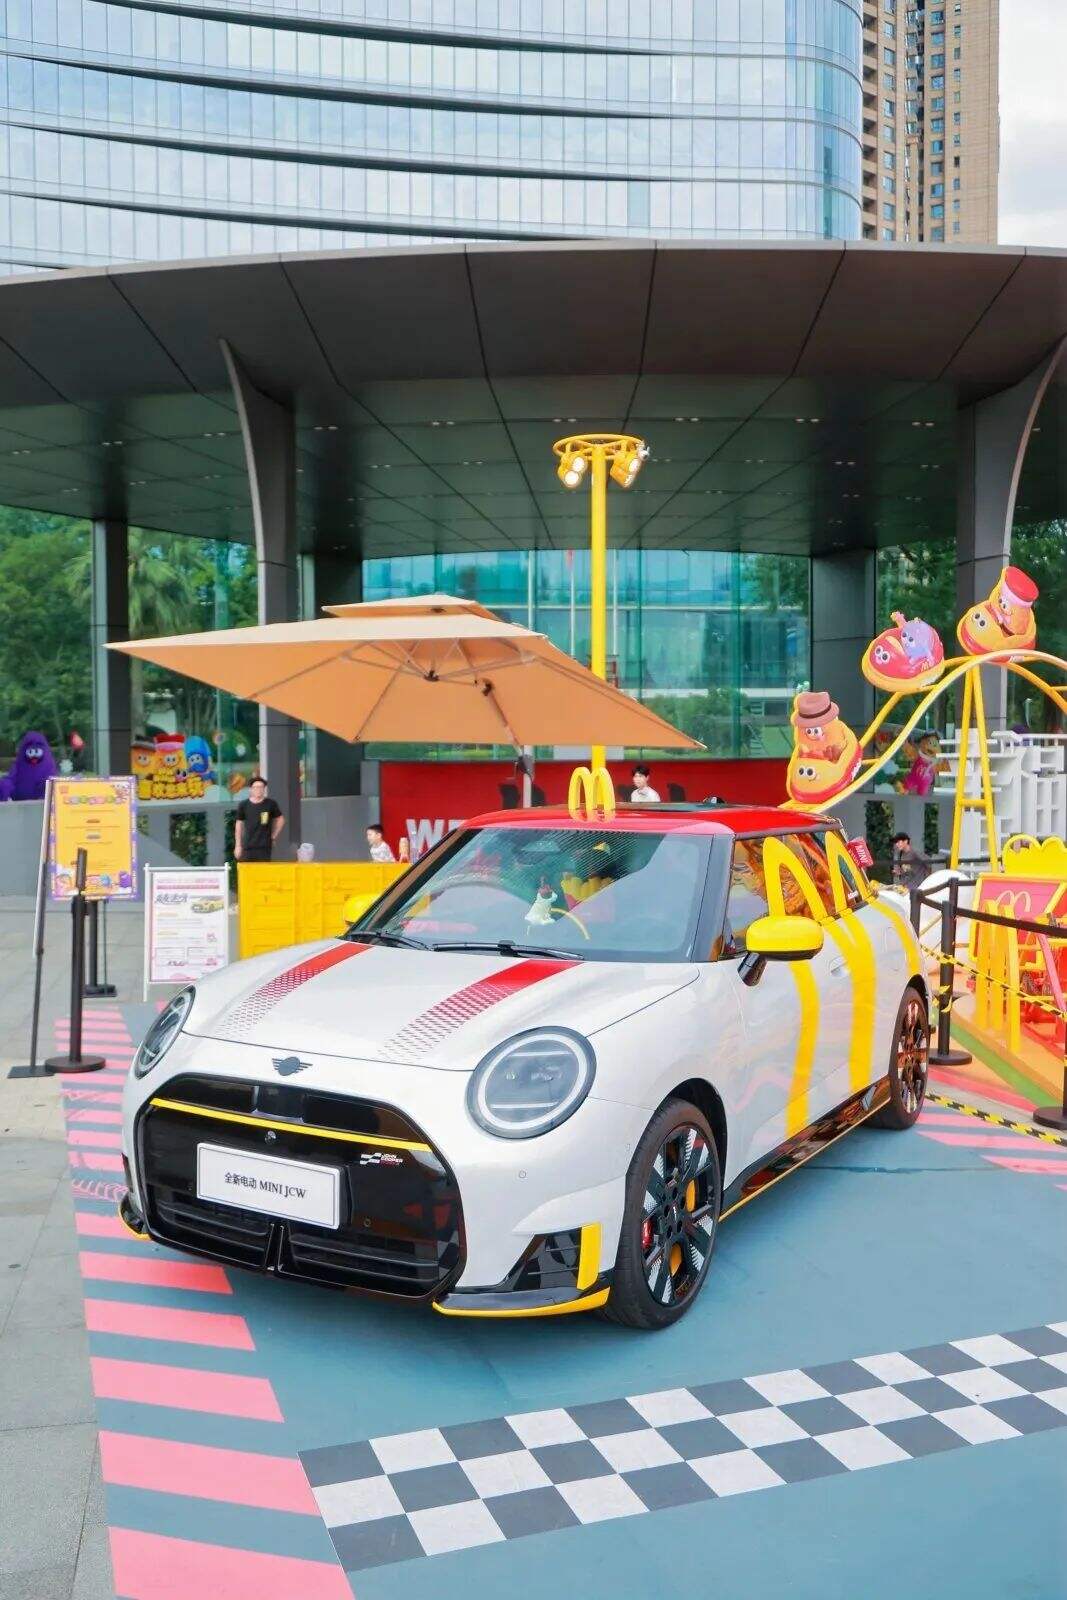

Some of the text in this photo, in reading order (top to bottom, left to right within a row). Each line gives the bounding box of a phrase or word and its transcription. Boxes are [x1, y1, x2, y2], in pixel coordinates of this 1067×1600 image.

[224, 1172, 307, 1199] 全新电动 MINI JCW
